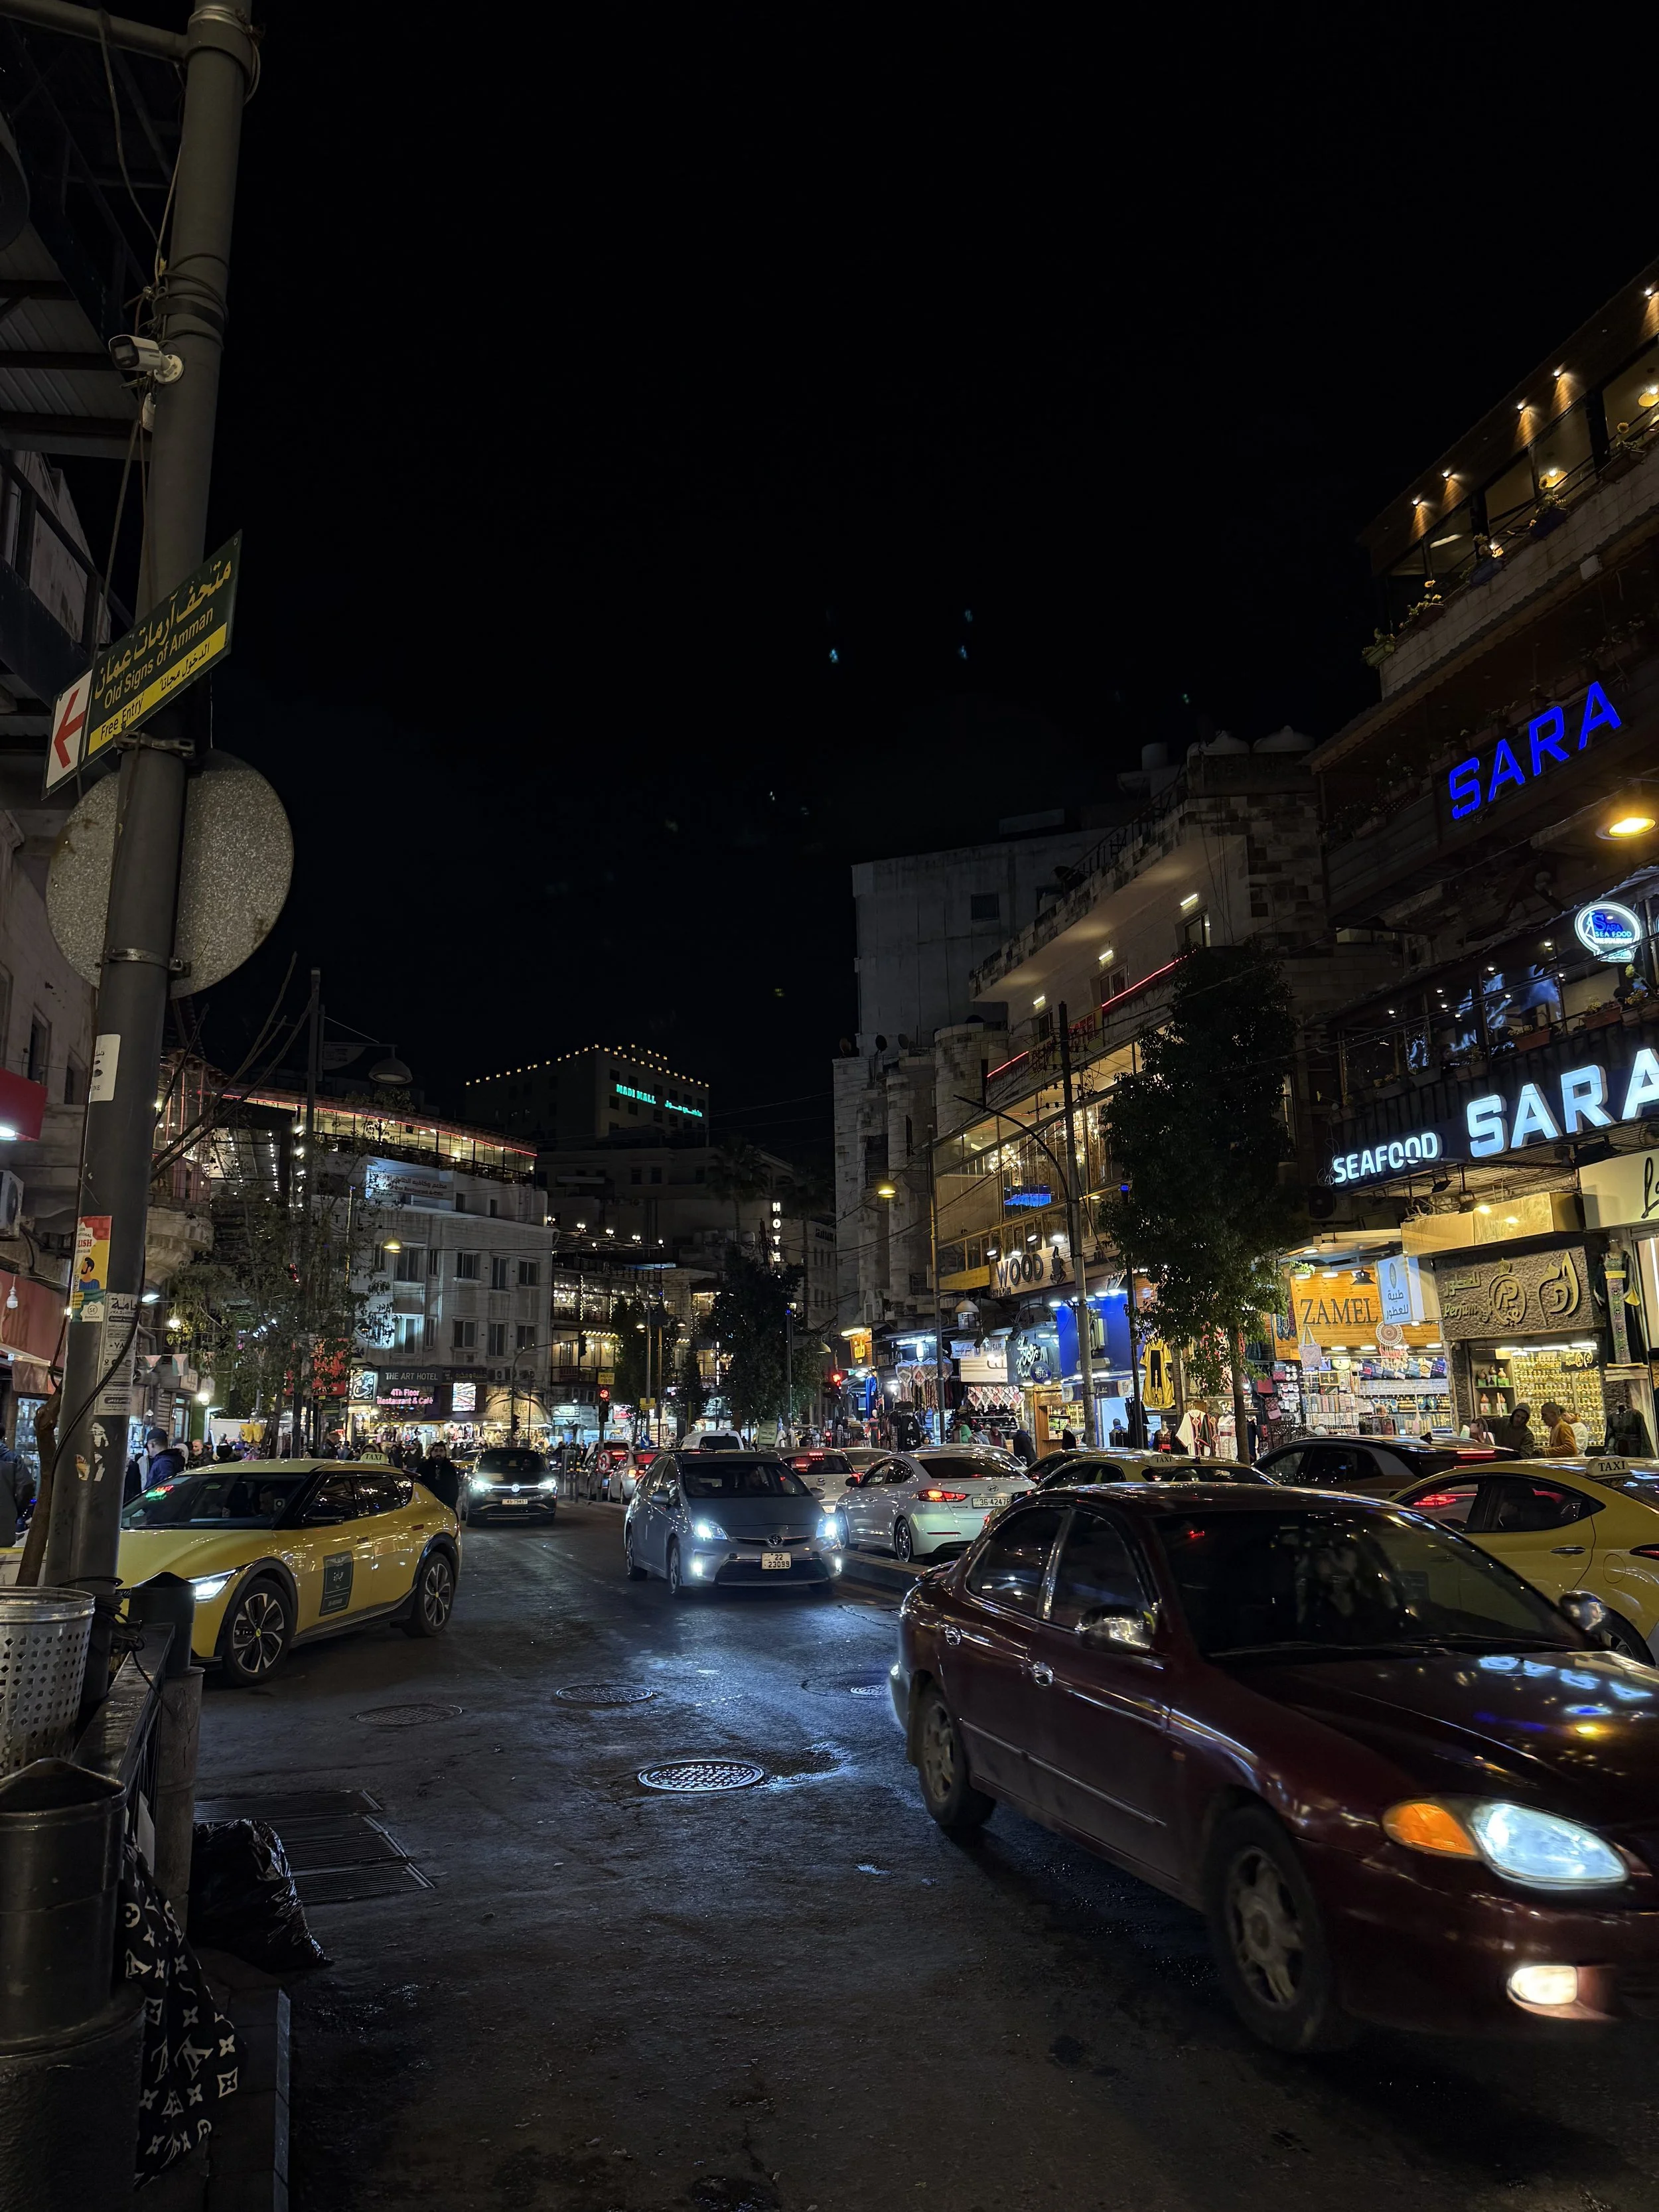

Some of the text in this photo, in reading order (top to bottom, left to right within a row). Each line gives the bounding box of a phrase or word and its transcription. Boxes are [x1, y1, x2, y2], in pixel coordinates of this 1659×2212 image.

[177, 560, 232, 623] متحف
[104, 607, 213, 709] Old Signs of Amman
[182, 641, 210, 678] الدخول
[100, 696, 144, 741] Free Entry
[1449, 680, 1623, 820] SARA
[636, 1090, 656, 1105] MALL
[1333, 1047, 1659, 1185] SEAFOOD SARA
[772, 1202, 782, 1262] HOTE
[996, 1253, 1044, 1288] WOOD
[1301, 1297, 1378, 1325] ZAMEL
[1386, 1304, 1409, 1321] للعطور
[376, 1396, 412, 1405] Restaurant
[1598, 1460, 1626, 1472] TAXI
